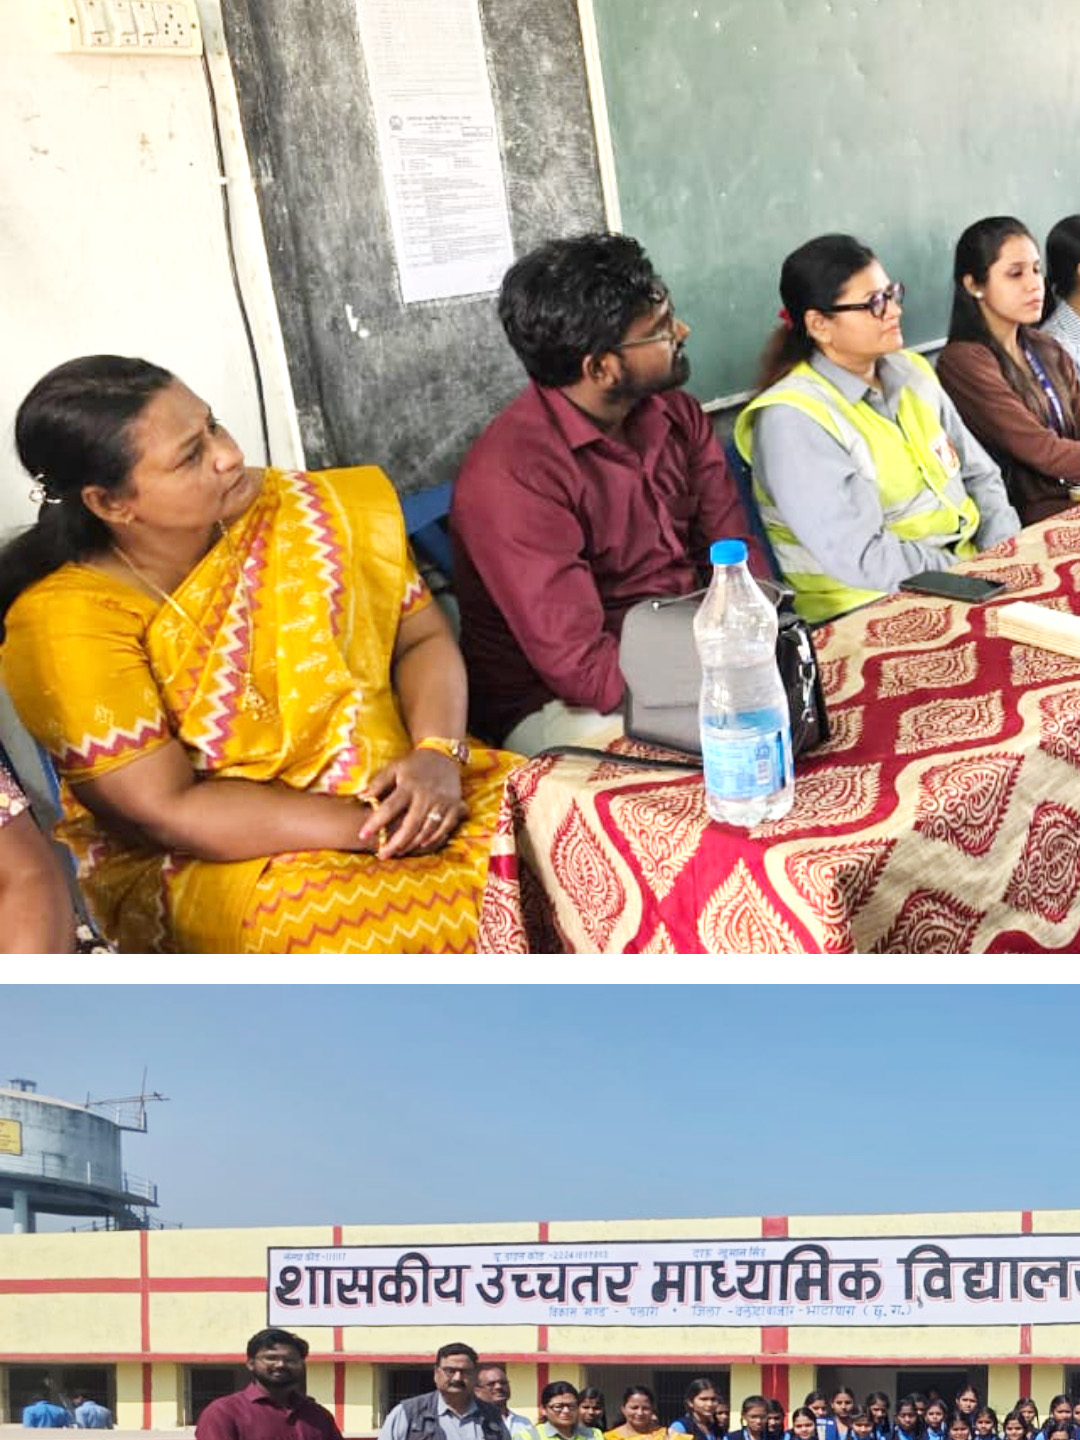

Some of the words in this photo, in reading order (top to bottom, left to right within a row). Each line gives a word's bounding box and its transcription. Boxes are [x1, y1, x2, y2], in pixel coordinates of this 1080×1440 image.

[275, 1251, 471, 1306] शासकीय
[476, 1262, 638, 1306] उच्चतर
[652, 1243, 882, 1304] माध्यमिक
